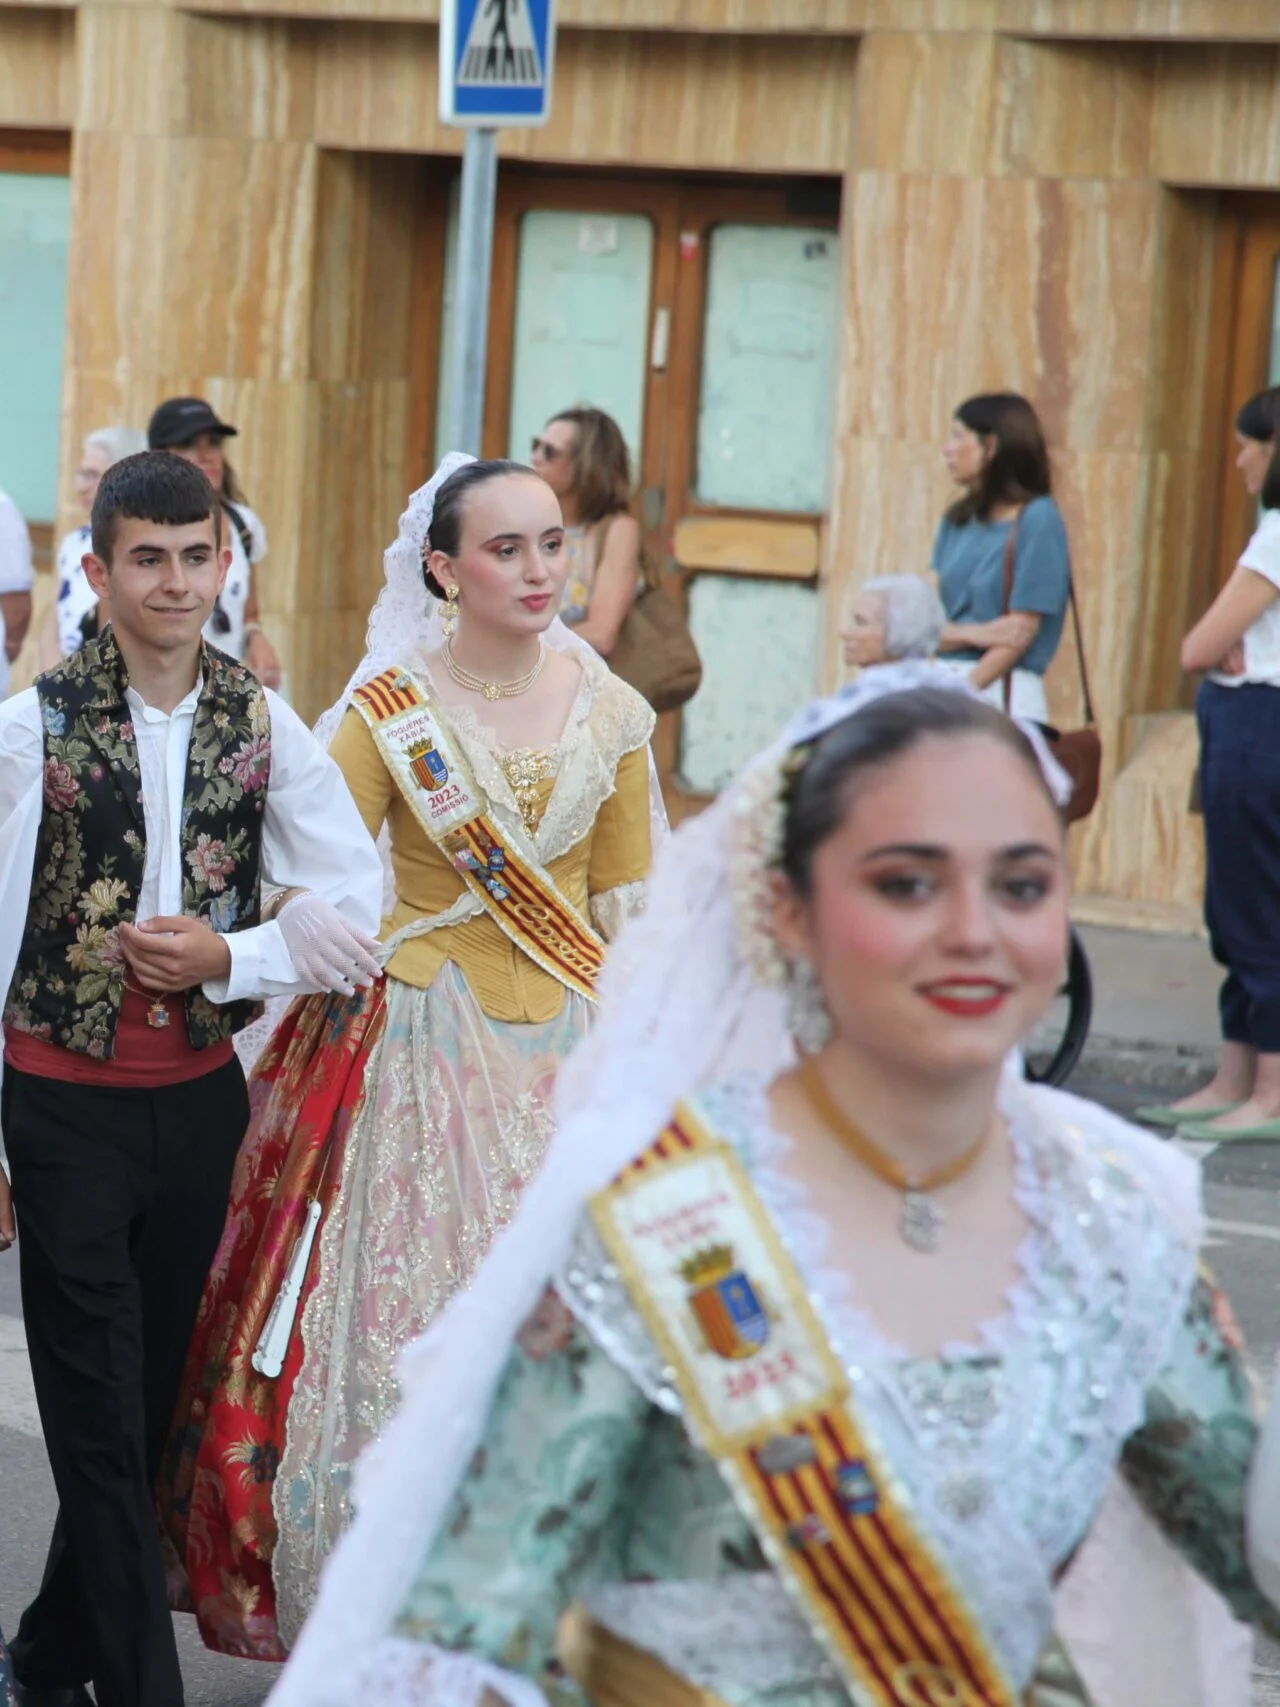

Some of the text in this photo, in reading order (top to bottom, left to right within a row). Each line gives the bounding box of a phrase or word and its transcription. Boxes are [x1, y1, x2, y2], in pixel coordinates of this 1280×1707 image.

[386, 714, 430, 740] FOGUERES
[427, 783, 462, 810] 2023
[513, 902, 578, 964] Cort
